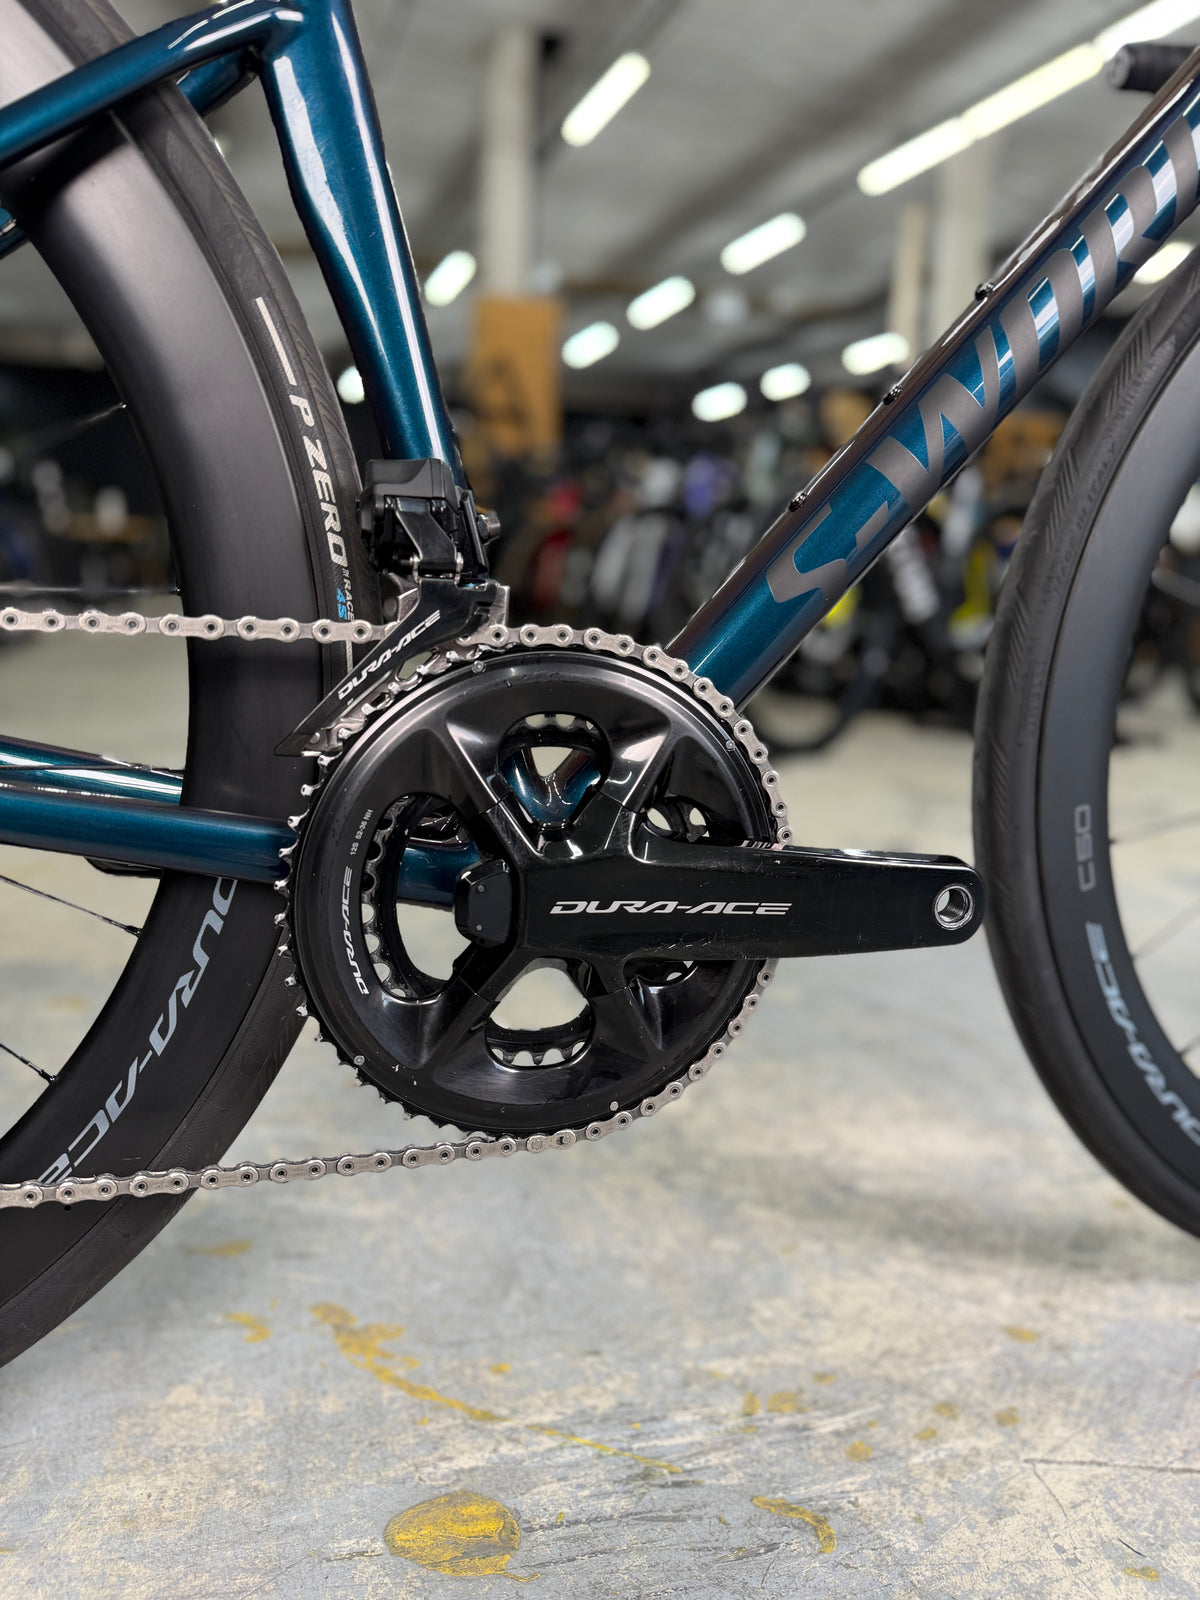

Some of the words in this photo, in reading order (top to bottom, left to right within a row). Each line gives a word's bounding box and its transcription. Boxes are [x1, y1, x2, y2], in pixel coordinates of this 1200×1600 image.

[288, 394, 315, 428] P
[301, 438, 348, 568] ZERO
[336, 588, 348, 620] 4S
[343, 578, 355, 621] RACE
[337, 609, 441, 700] DURA-ACE
[1074, 804, 1097, 892] C50
[341, 865, 370, 995] DURA-ACE
[549, 899, 793, 916] DURA-ACE
